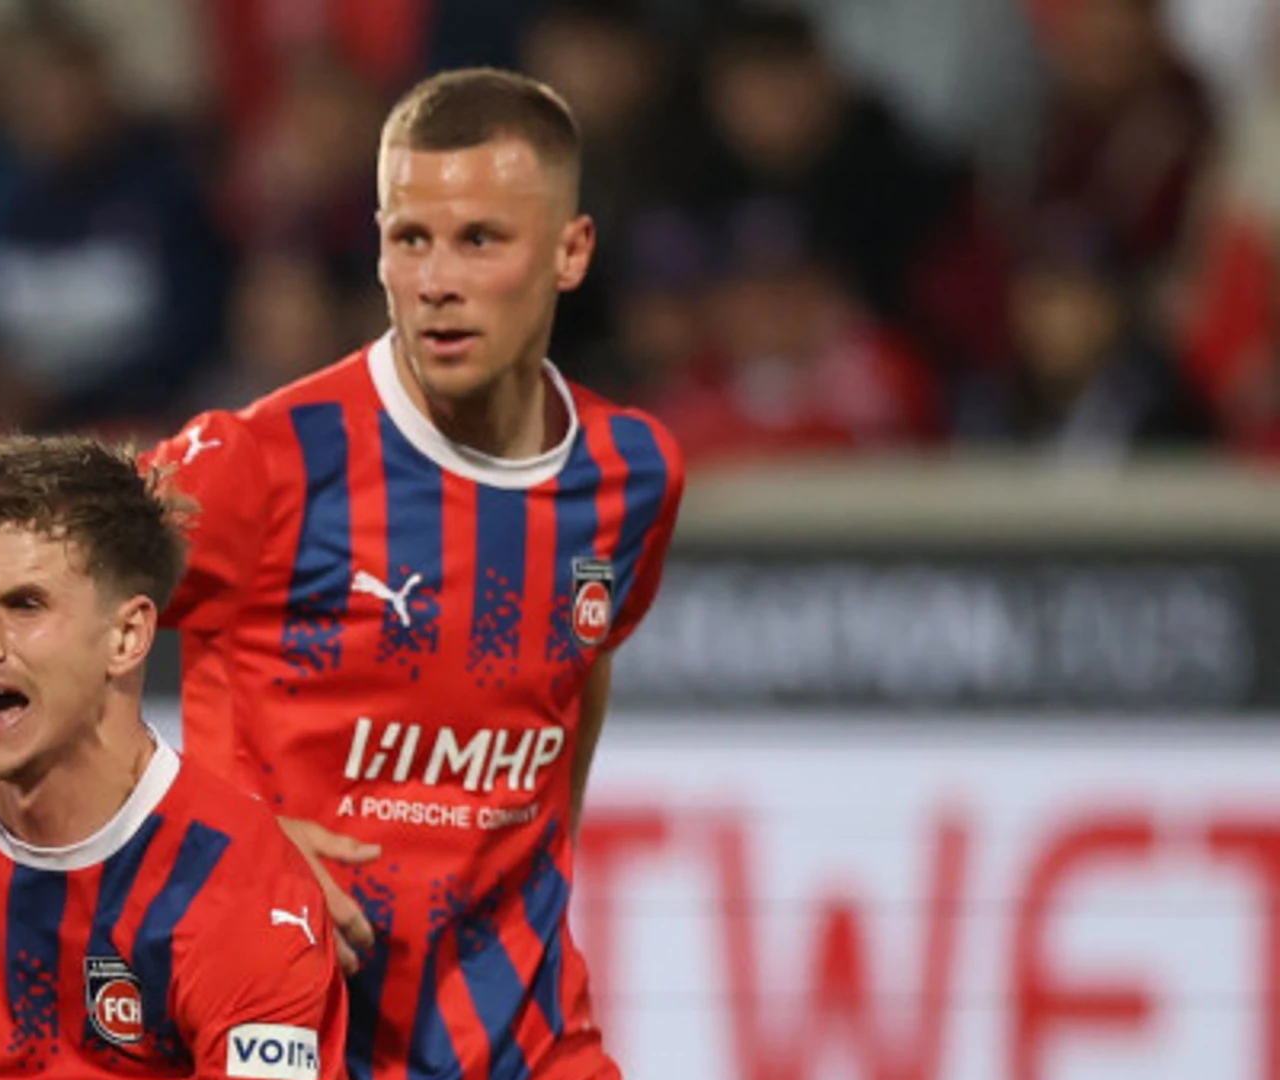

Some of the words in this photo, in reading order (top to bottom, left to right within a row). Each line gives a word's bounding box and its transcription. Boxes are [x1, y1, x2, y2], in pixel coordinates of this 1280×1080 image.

[423, 726, 564, 791] MHP
[337, 796, 355, 817] A
[361, 796, 472, 831] PORSCHE
